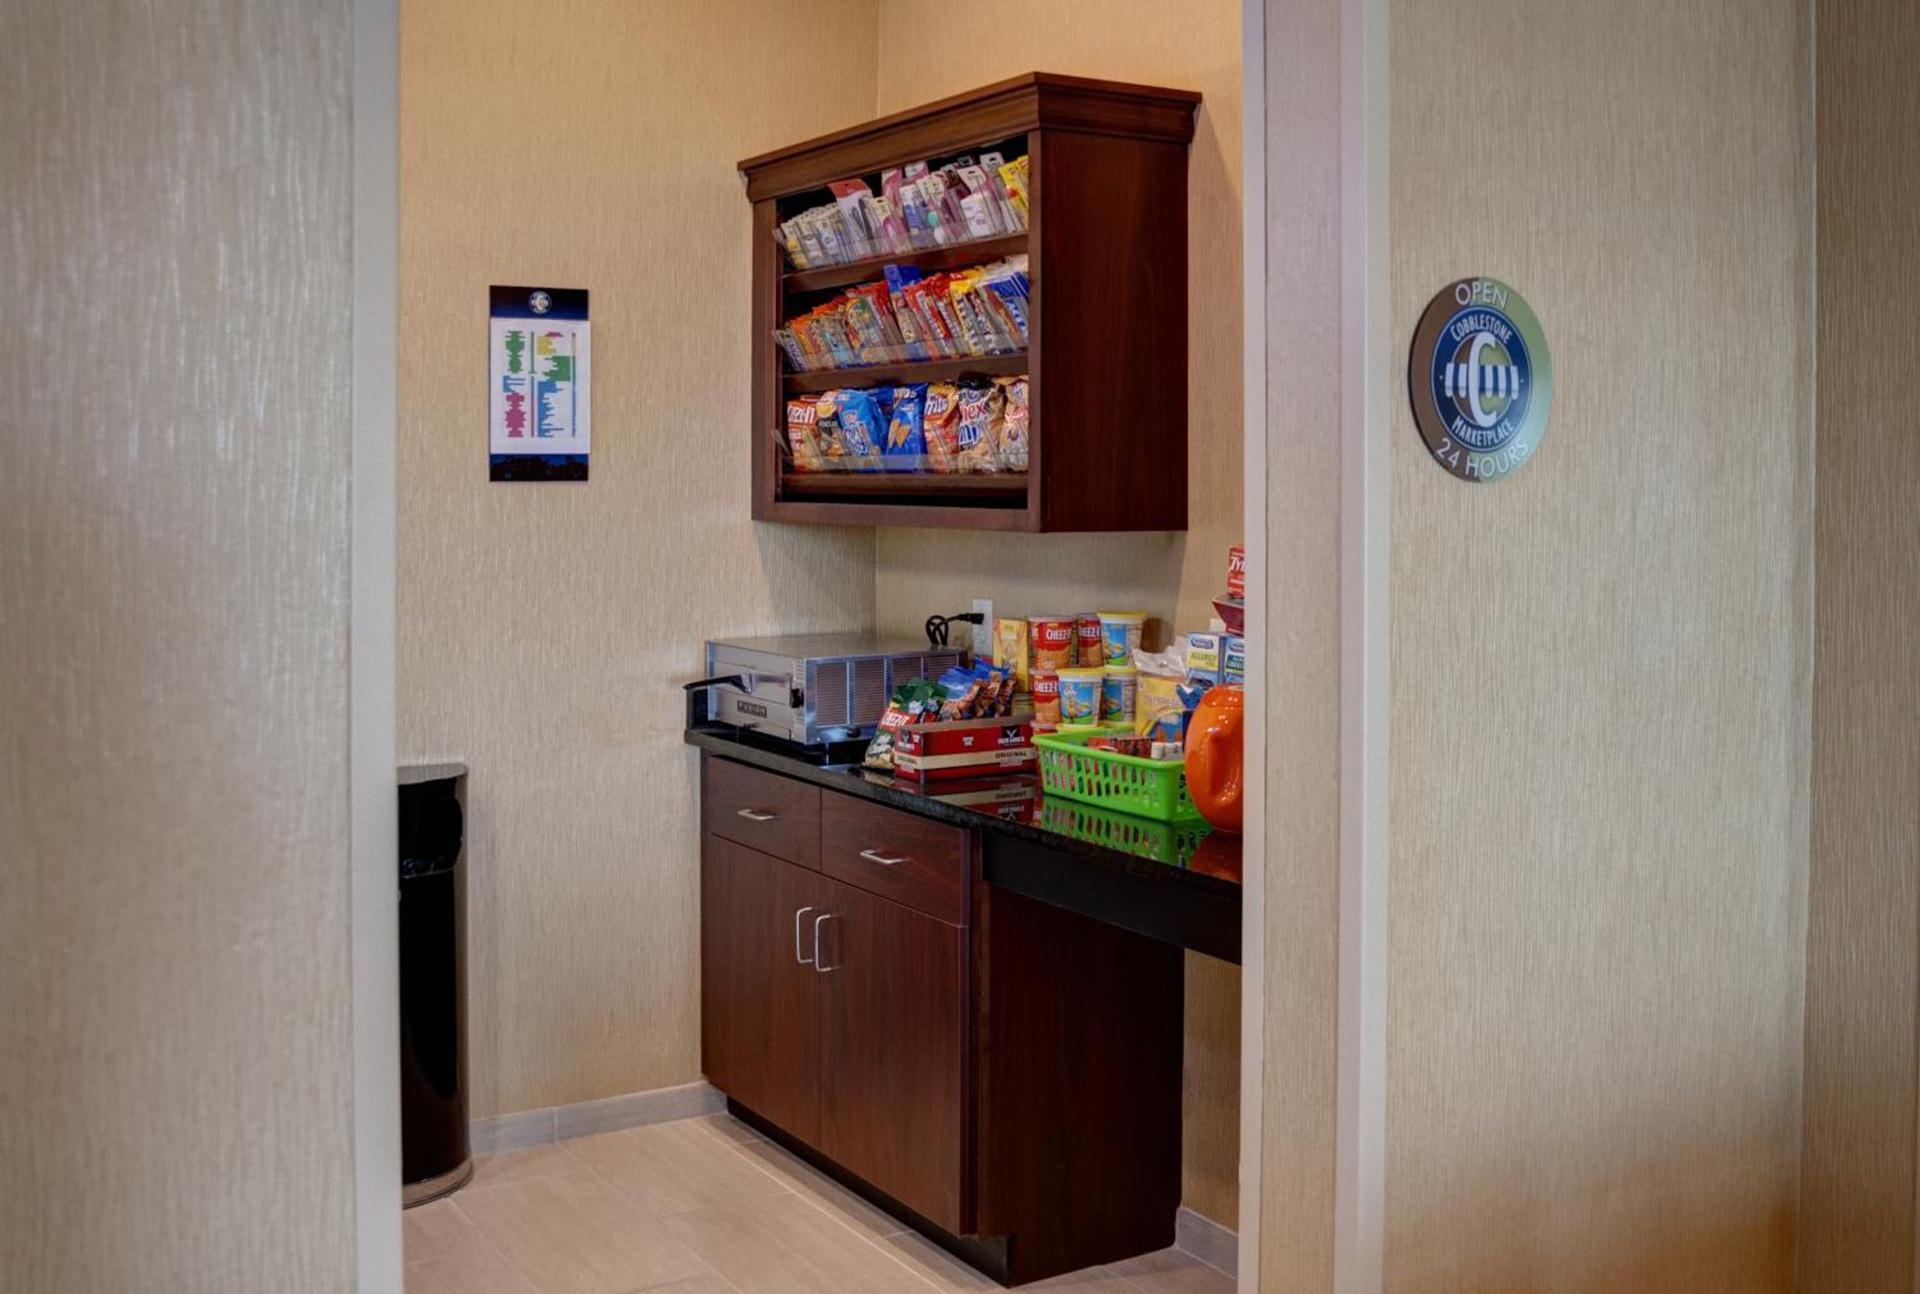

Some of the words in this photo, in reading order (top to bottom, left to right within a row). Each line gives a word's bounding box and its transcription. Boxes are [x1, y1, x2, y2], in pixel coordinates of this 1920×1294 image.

[1455, 280, 1509, 309] OPEN
[1450, 314, 1514, 345] COBBLESTONE
[1451, 416, 1515, 445] MARKETPLACE
[1436, 437, 1458, 469] 24
[1465, 438, 1530, 477] HOURS
